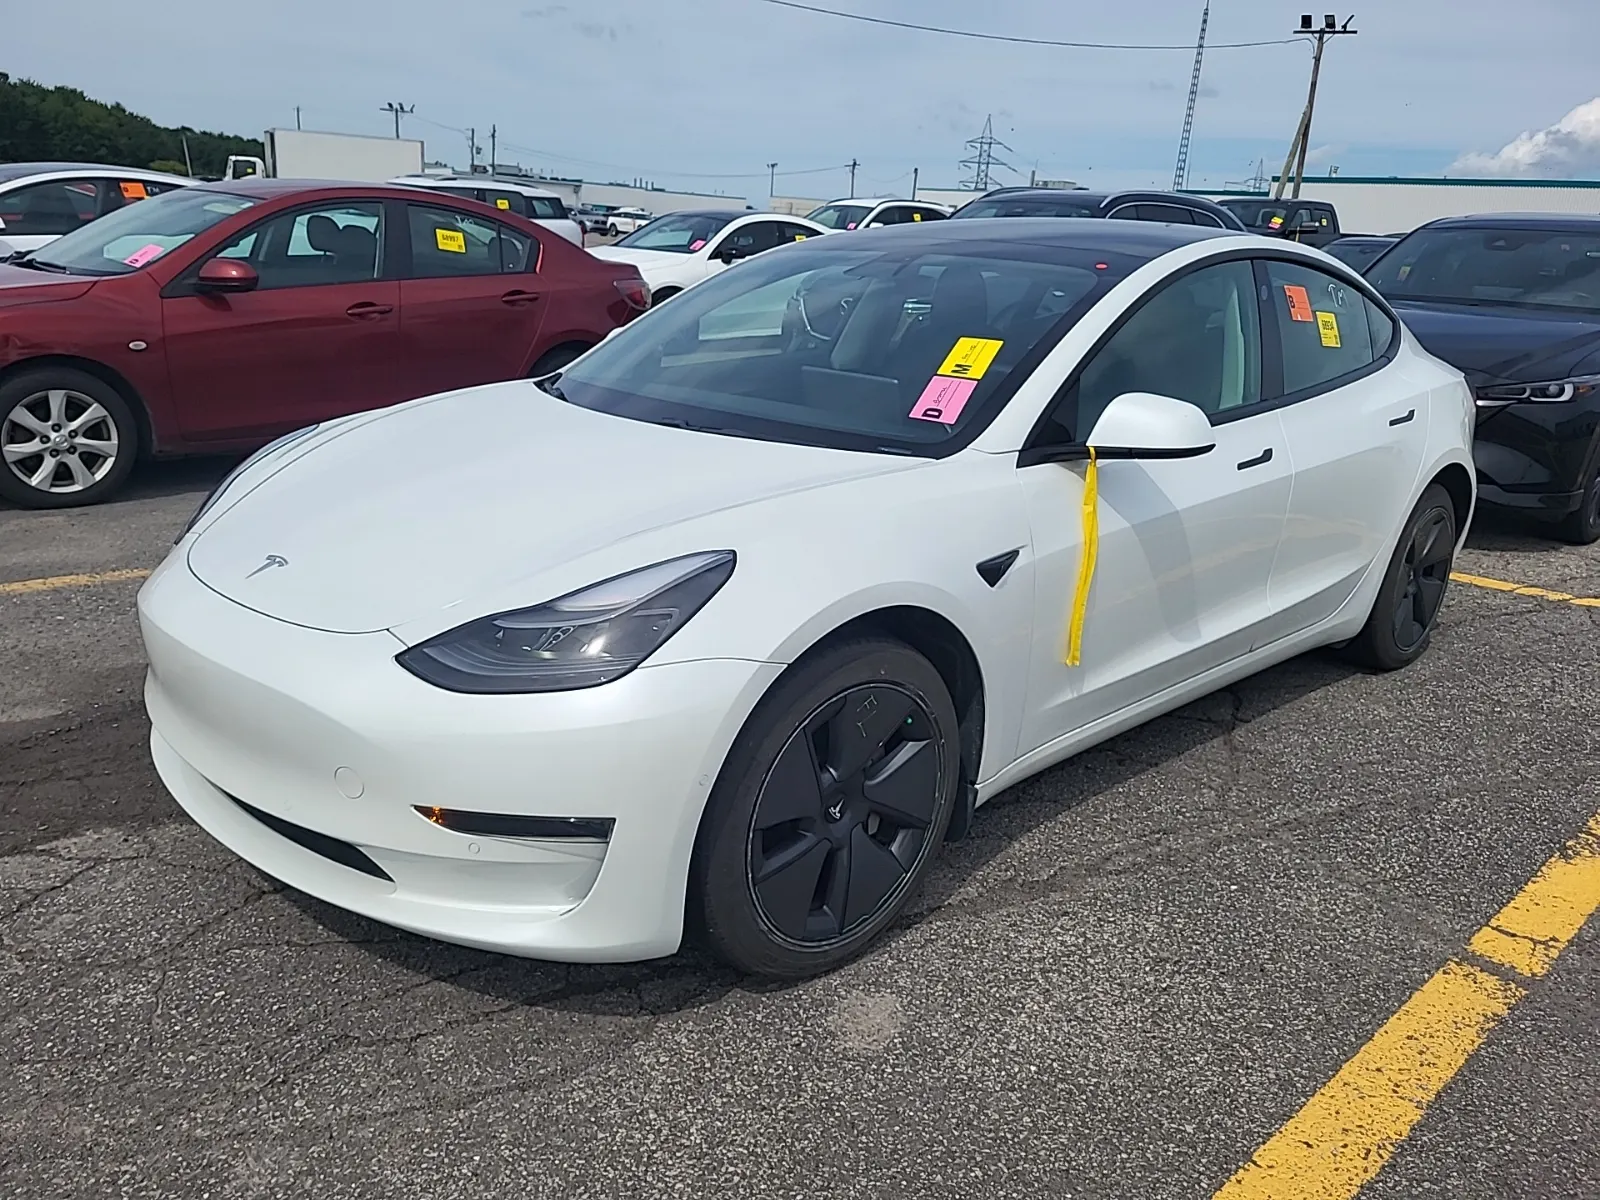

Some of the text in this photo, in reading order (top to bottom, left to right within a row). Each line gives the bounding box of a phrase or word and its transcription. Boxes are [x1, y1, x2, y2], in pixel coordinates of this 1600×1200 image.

[1287, 295, 1295, 308] B
[951, 363, 972, 375] M
[921, 407, 943, 419] D
